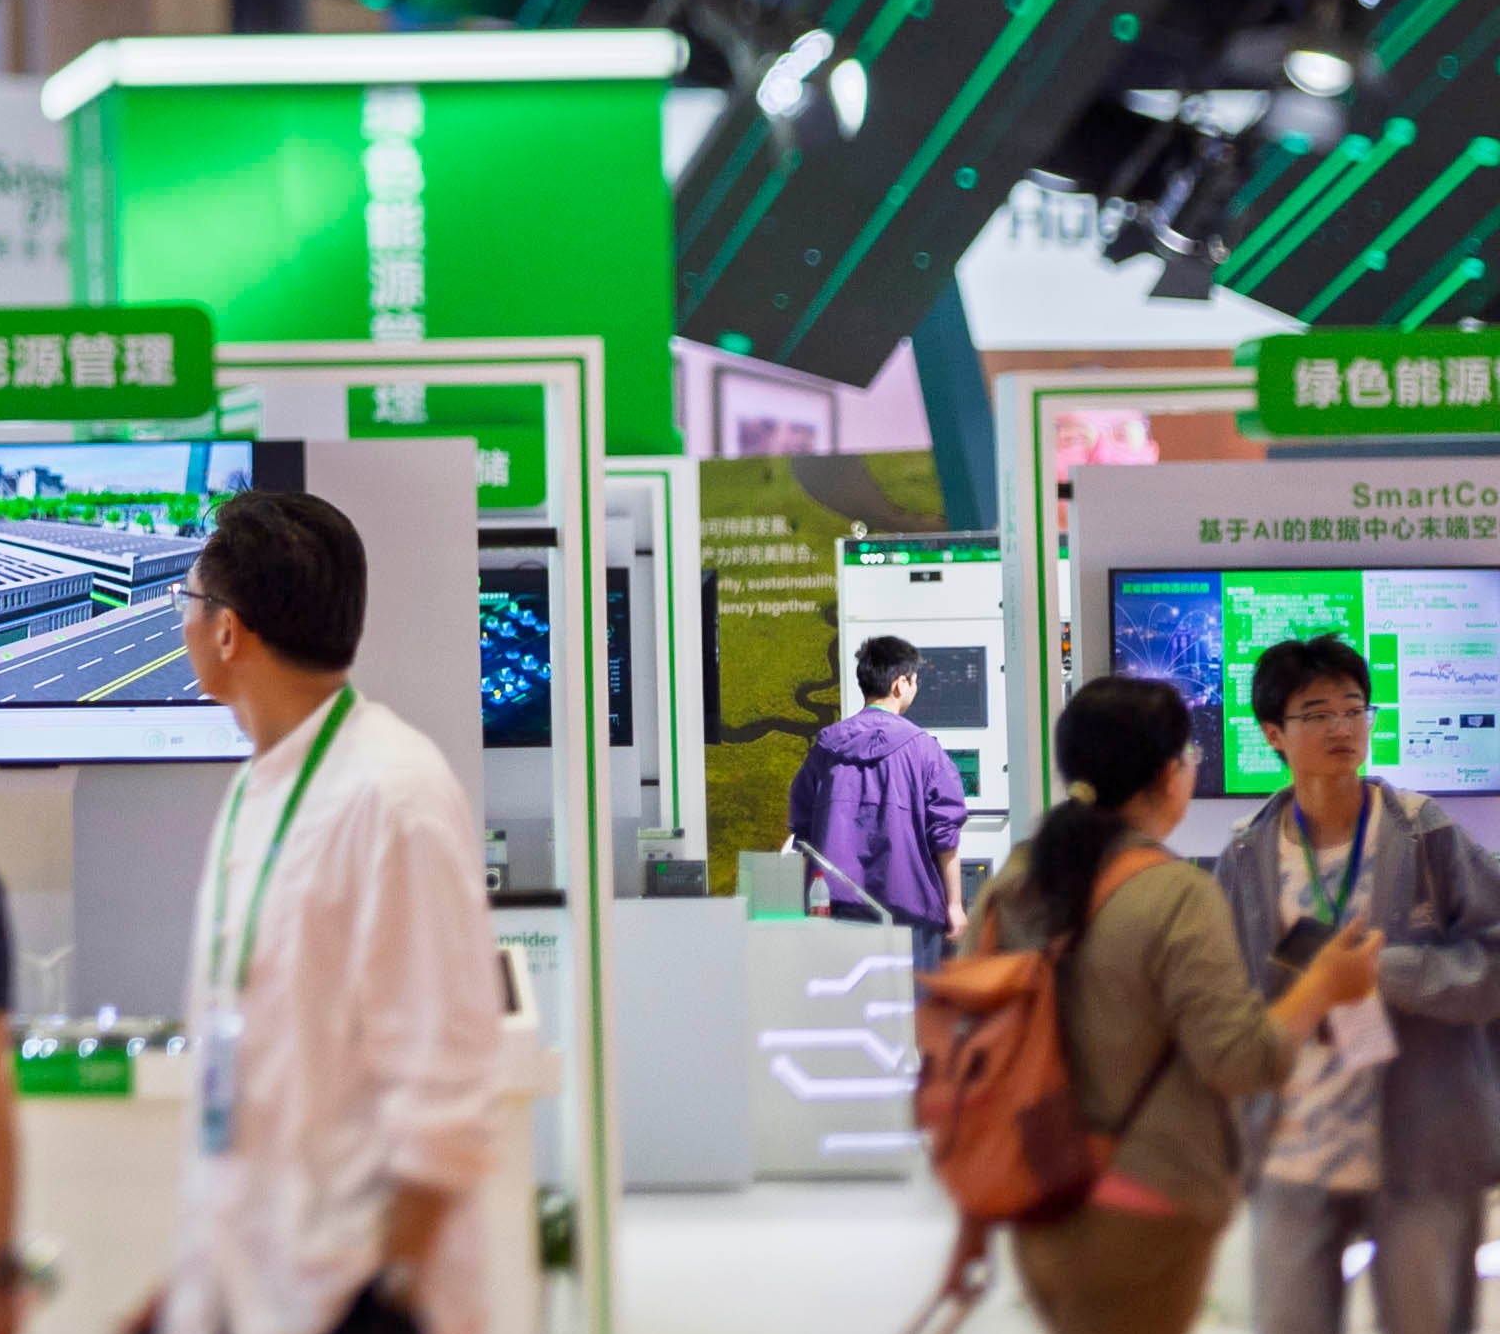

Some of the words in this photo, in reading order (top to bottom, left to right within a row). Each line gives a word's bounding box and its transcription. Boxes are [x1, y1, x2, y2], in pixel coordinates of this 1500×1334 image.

[1295, 355, 1500, 409] 绿色能源
[1353, 481, 1500, 508] SmartCo
[1199, 515, 1500, 544] 基于AI的数据中心末端空
[719, 601, 755, 618] iency
